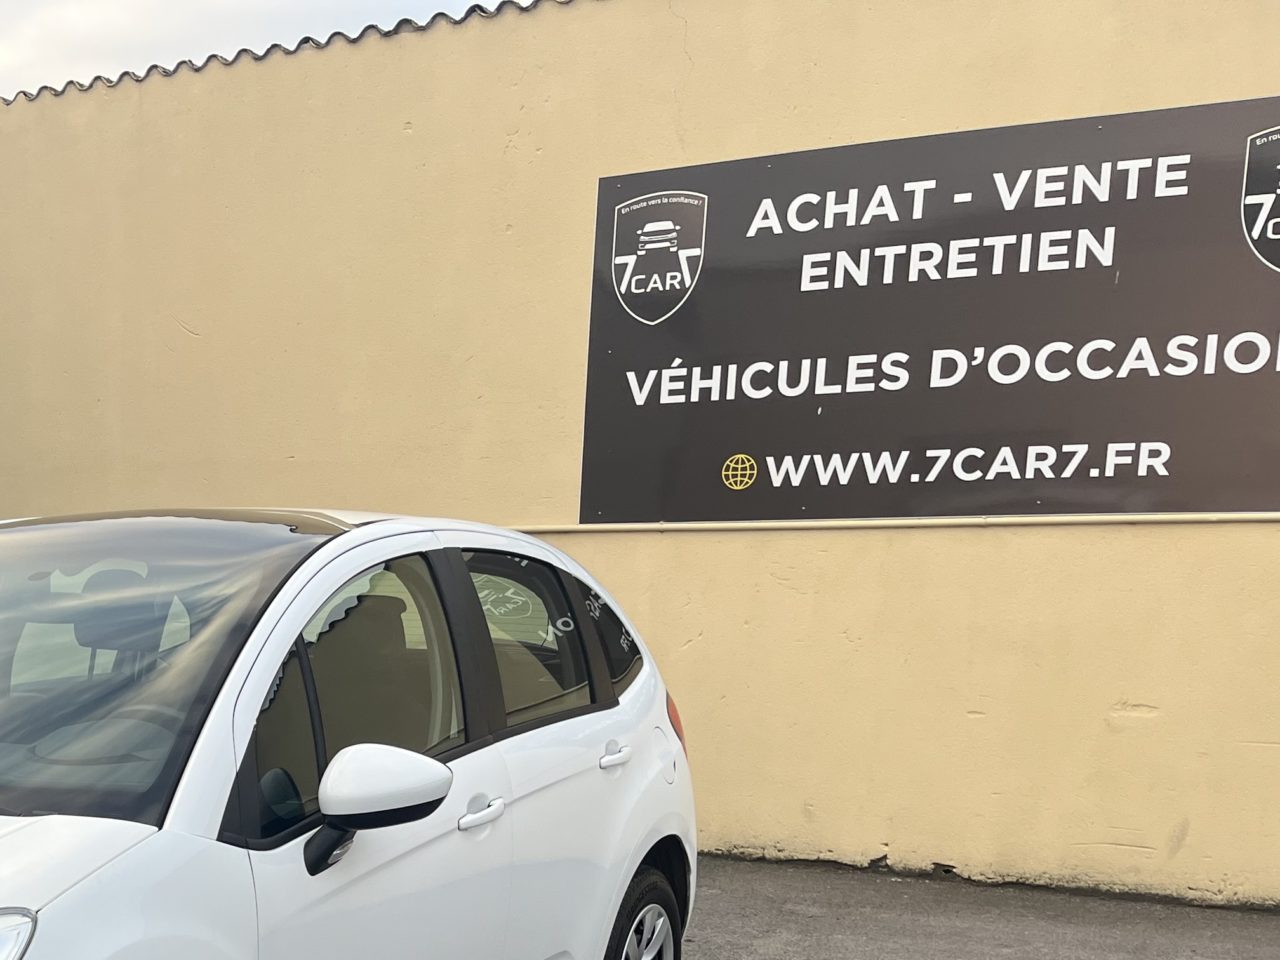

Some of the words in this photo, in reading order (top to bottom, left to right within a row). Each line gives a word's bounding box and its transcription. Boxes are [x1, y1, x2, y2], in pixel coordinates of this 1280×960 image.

[630, 201, 647, 211] route
[746, 180, 936, 237] ACHAT
[993, 154, 1191, 211] VENTE
[800, 227, 1116, 292] ENTRETIEN
[626, 352, 910, 406] VÉHICULES
[929, 331, 1280, 388] D'OCCASIO
[766, 442, 1171, 488] WWW.7CAR7.FR
